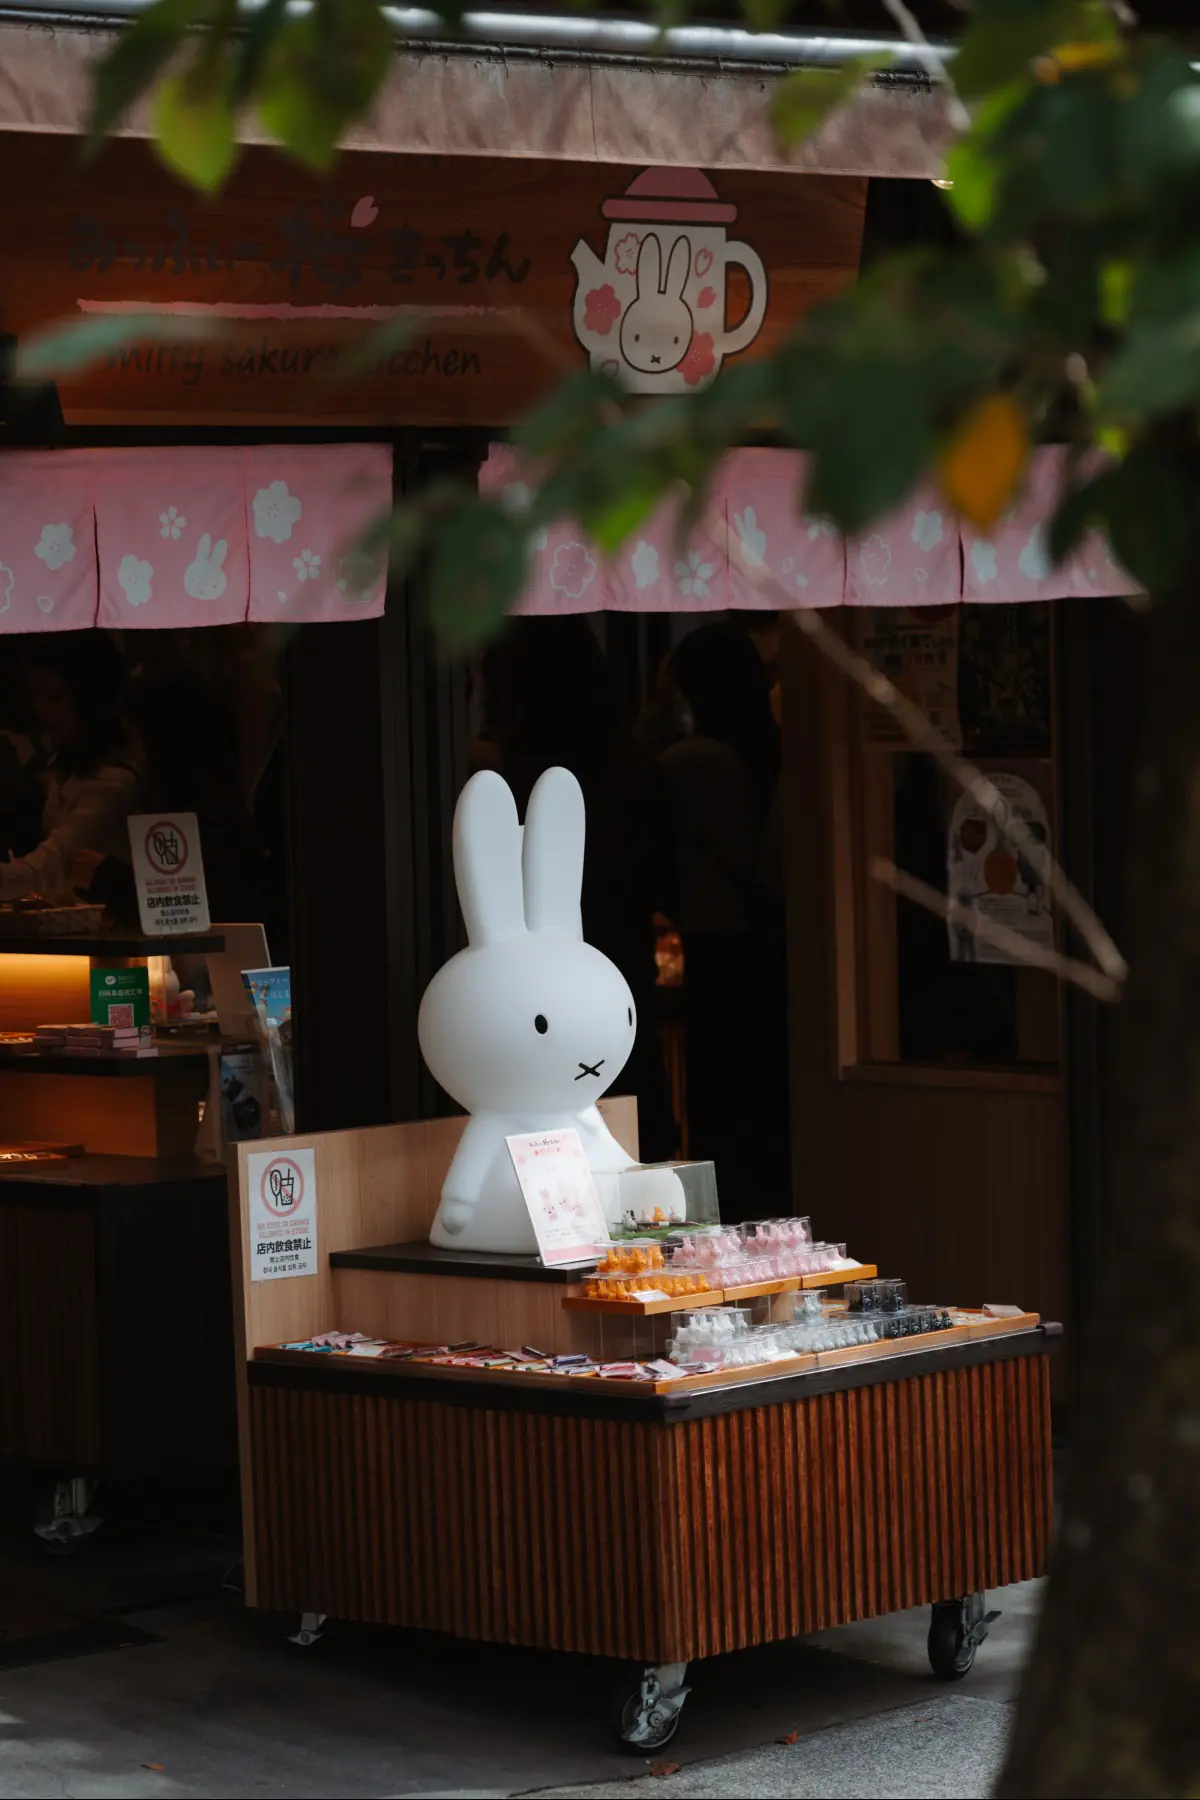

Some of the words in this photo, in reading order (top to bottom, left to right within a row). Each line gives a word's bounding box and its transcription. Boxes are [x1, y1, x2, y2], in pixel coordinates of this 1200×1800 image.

[256, 1237, 312, 1254] 店内飲食禁止
